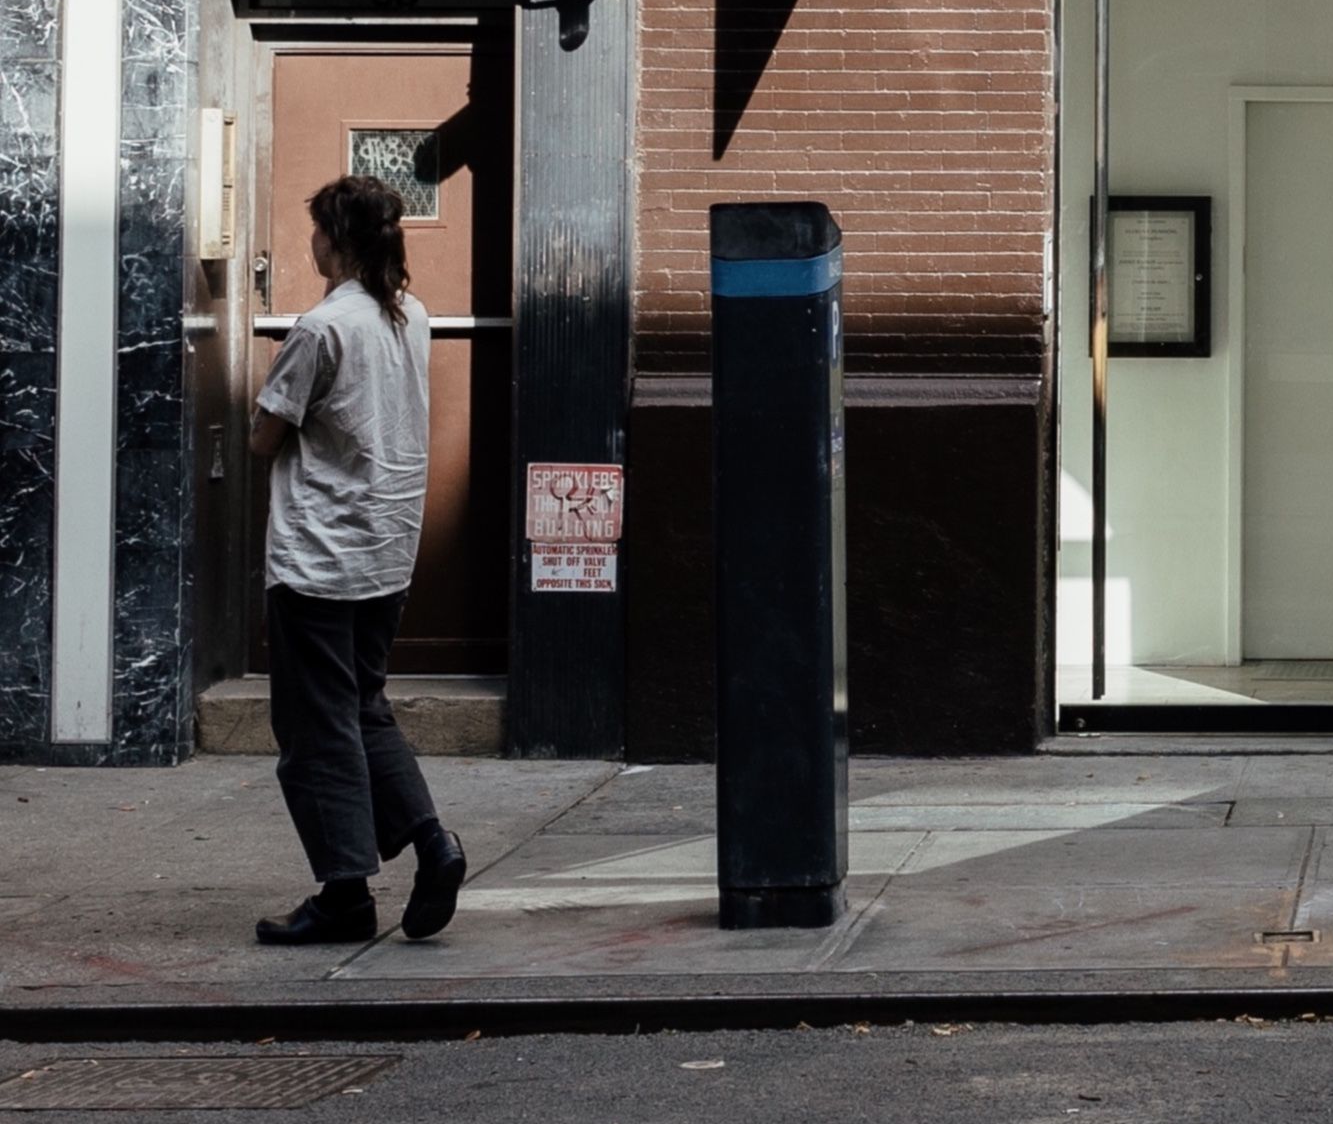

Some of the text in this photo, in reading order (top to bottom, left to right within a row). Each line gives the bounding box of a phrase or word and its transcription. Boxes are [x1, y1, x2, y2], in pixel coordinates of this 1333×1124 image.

[533, 545, 574, 555] AUTOMATIC
[542, 557, 607, 567] SHUT OFF VALVE
[583, 568, 602, 577] FEET
[536, 579, 572, 589] OPPOSITE
[575, 579, 592, 589] THIS
